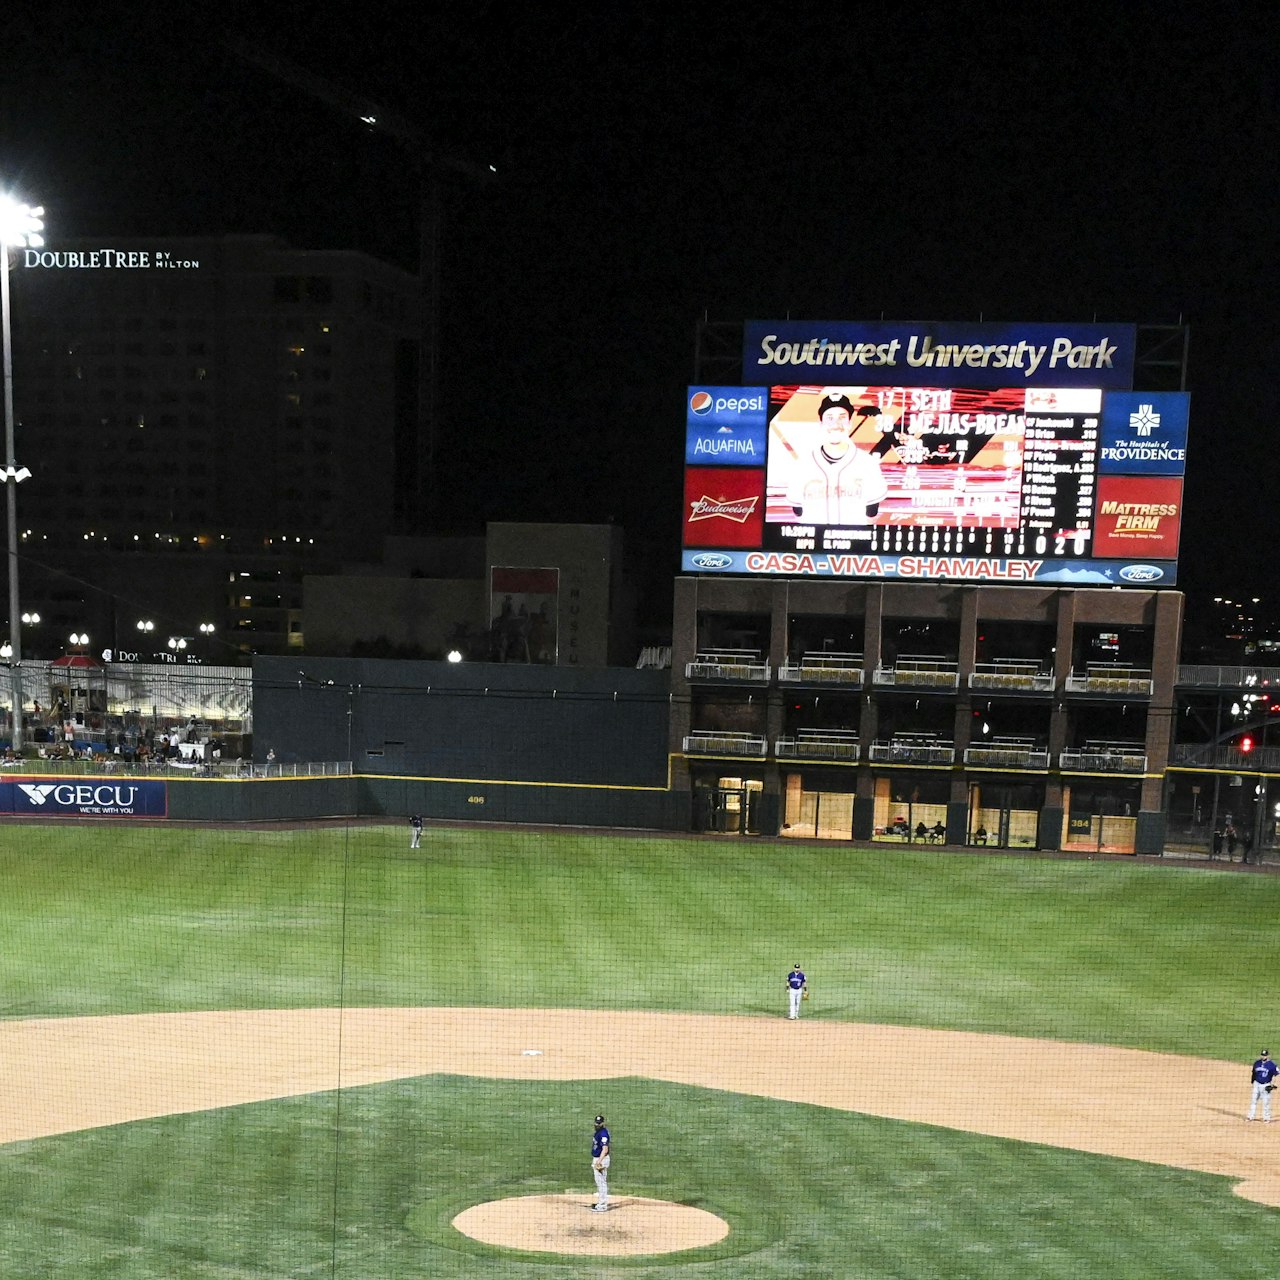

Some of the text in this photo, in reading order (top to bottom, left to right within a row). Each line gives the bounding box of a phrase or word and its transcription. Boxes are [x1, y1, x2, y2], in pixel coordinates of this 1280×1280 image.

[156, 252, 171, 260] BY
[156, 260, 200, 269] HILTON
[757, 334, 1118, 378] Southwest University Park
[715, 395, 763, 413] pepsi
[908, 389, 952, 411] SETH
[694, 437, 756, 455] AQUAFINA
[1114, 440, 1168, 449] The Hospitals of
[1101, 447, 1185, 461] PROVIDENCE
[695, 500, 756, 514] Budweiser
[1100, 501, 1177, 516] MATTRESS
[1114, 515, 1160, 530] FIRM
[1054, 537, 1066, 555] 2
[698, 555, 725, 567] Ford
[746, 553, 816, 572] CASA
[827, 555, 881, 574] VIVA
[897, 556, 1044, 580] SHAMALEY
[1127, 568, 1155, 580] Ford
[54, 785, 135, 806] GECU
[1071, 819, 1089, 828] 384
